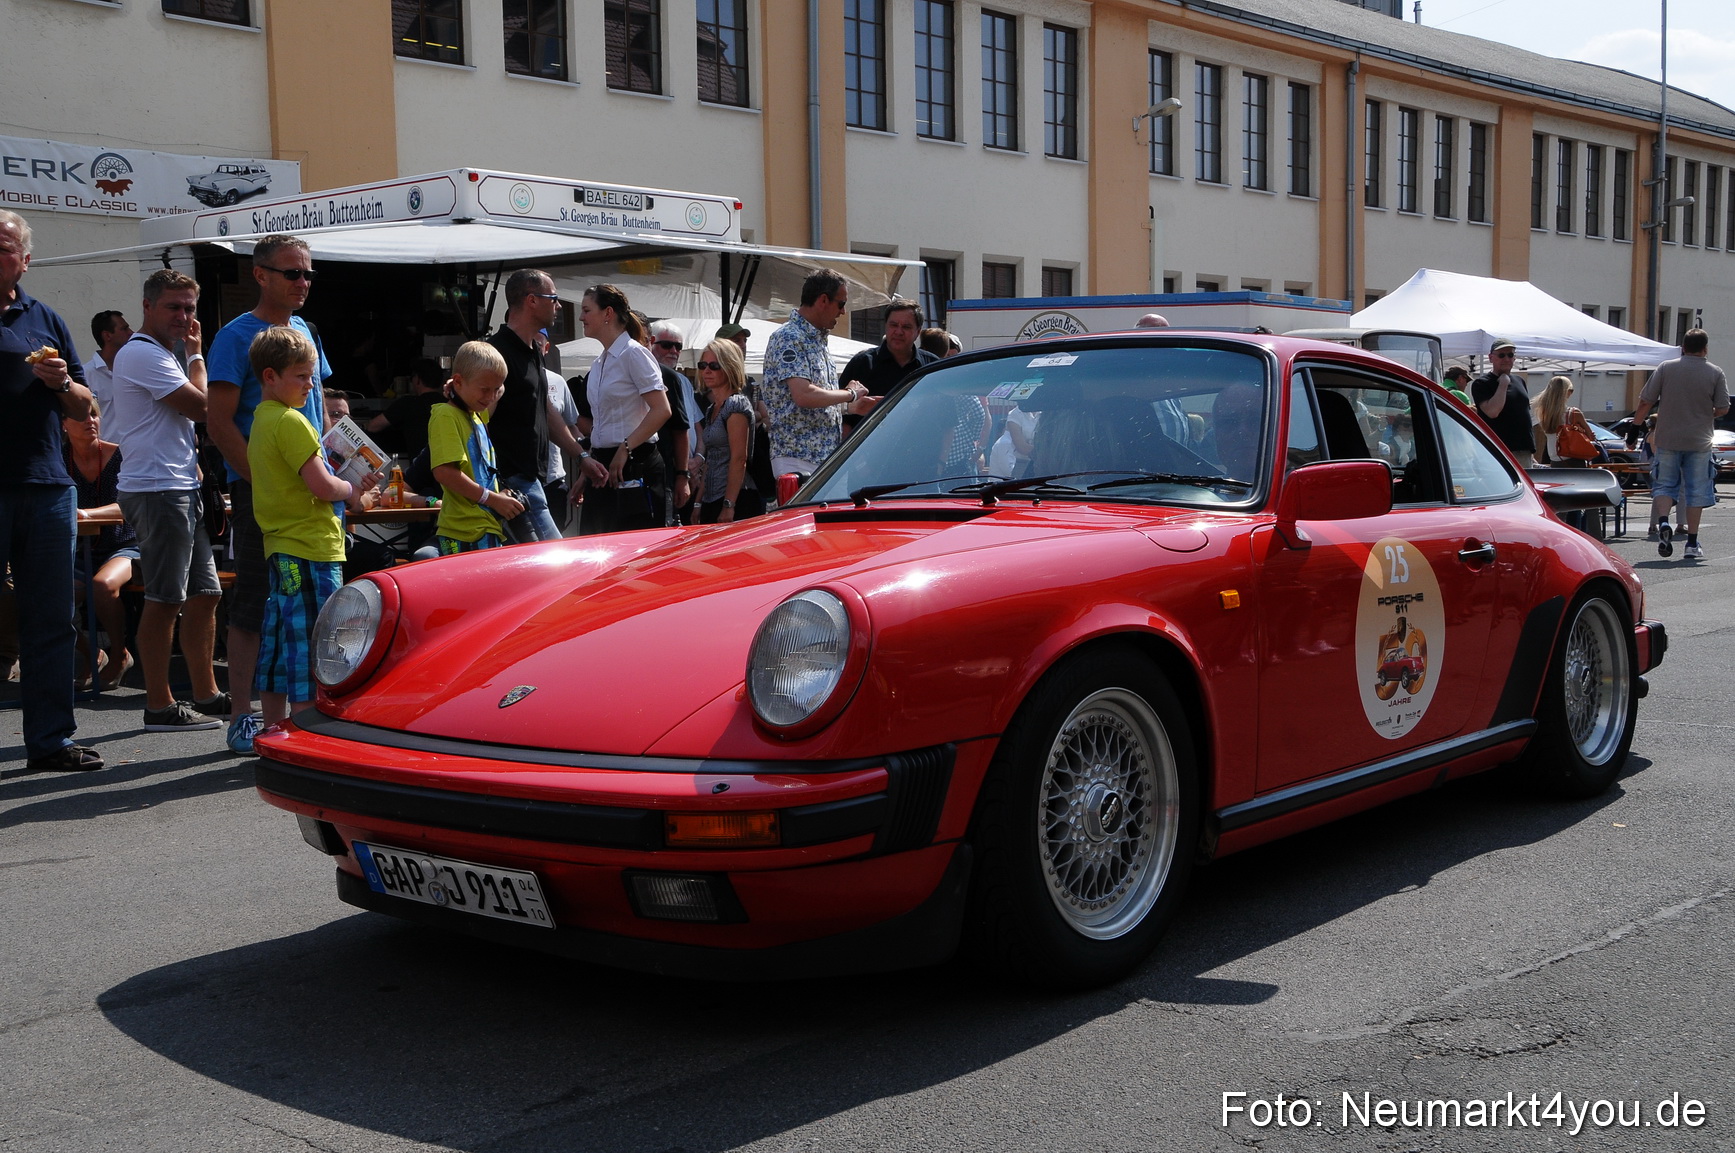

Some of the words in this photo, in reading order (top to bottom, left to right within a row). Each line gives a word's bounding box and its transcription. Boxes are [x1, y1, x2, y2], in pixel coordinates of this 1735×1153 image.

[65, 195, 138, 212] CLASSIC
[622, 194, 640, 207] 642
[302, 202, 324, 229] Bräu
[329, 196, 384, 225] Buttenheim
[601, 211, 618, 227] Bräu
[622, 214, 661, 231] Buttenheim
[1694, 308, 1703, 329] 5
[1384, 545, 1410, 584] 25
[1377, 592, 1424, 606] PORSCHE
[1395, 603, 1408, 614] 911
[1388, 696, 1412, 708] JAHRE
[370, 872, 378, 884] D
[372, 851, 425, 897] GAP
[518, 878, 535, 893] 04
[465, 870, 528, 918] 911
[531, 907, 546, 921] 10
